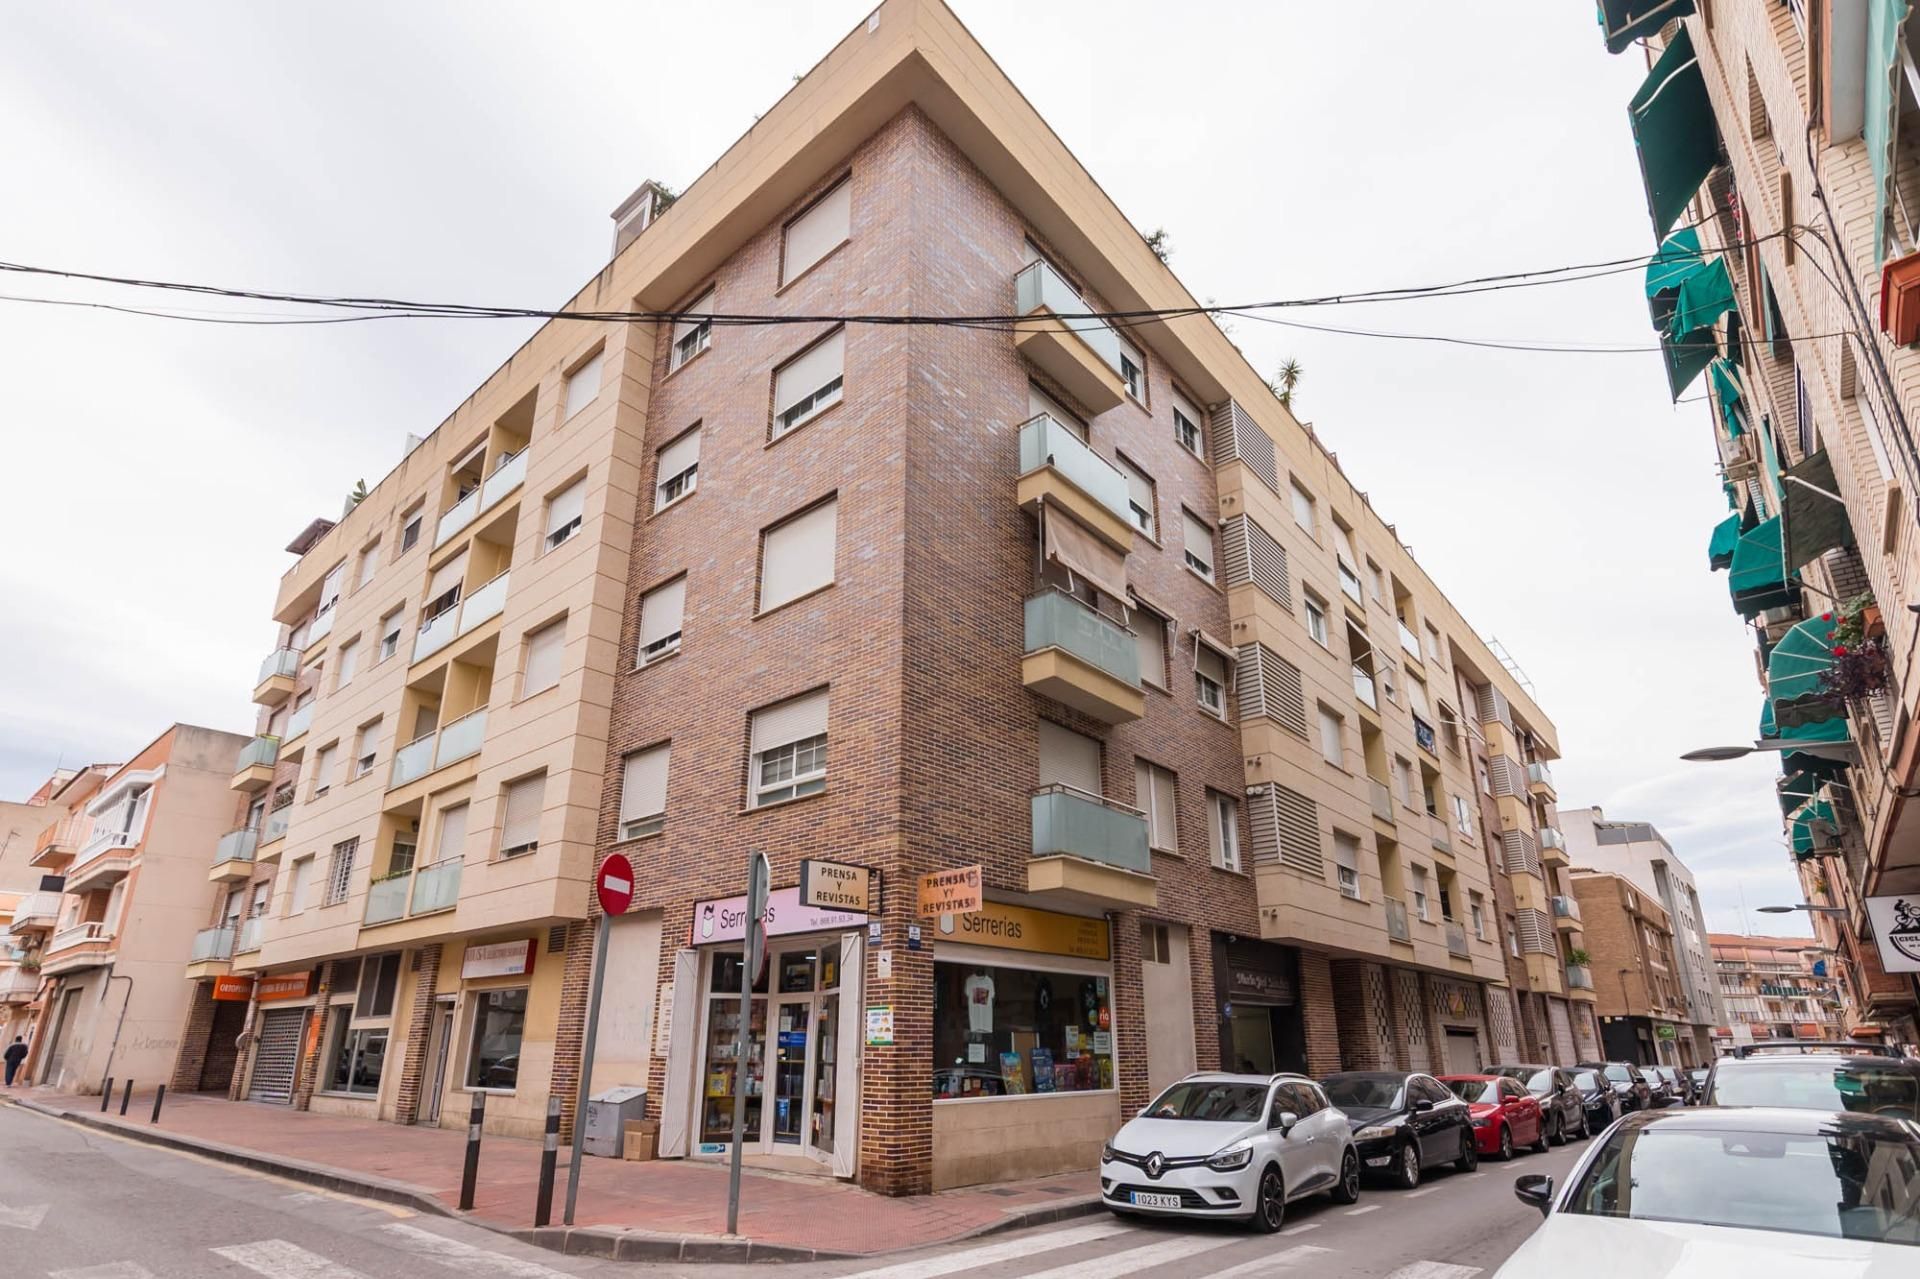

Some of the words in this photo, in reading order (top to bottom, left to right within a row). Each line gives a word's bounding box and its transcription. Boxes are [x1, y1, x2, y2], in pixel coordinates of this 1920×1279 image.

[821, 867, 857, 881] PRENSA
[926, 873, 965, 888] PRENSA
[836, 881, 842, 891] Y
[816, 891, 861, 905] REVISTAS
[923, 898, 970, 913] REVISTAS
[1137, 1194, 1158, 1206] 1023
[1160, 1196, 1179, 1207] KYS
